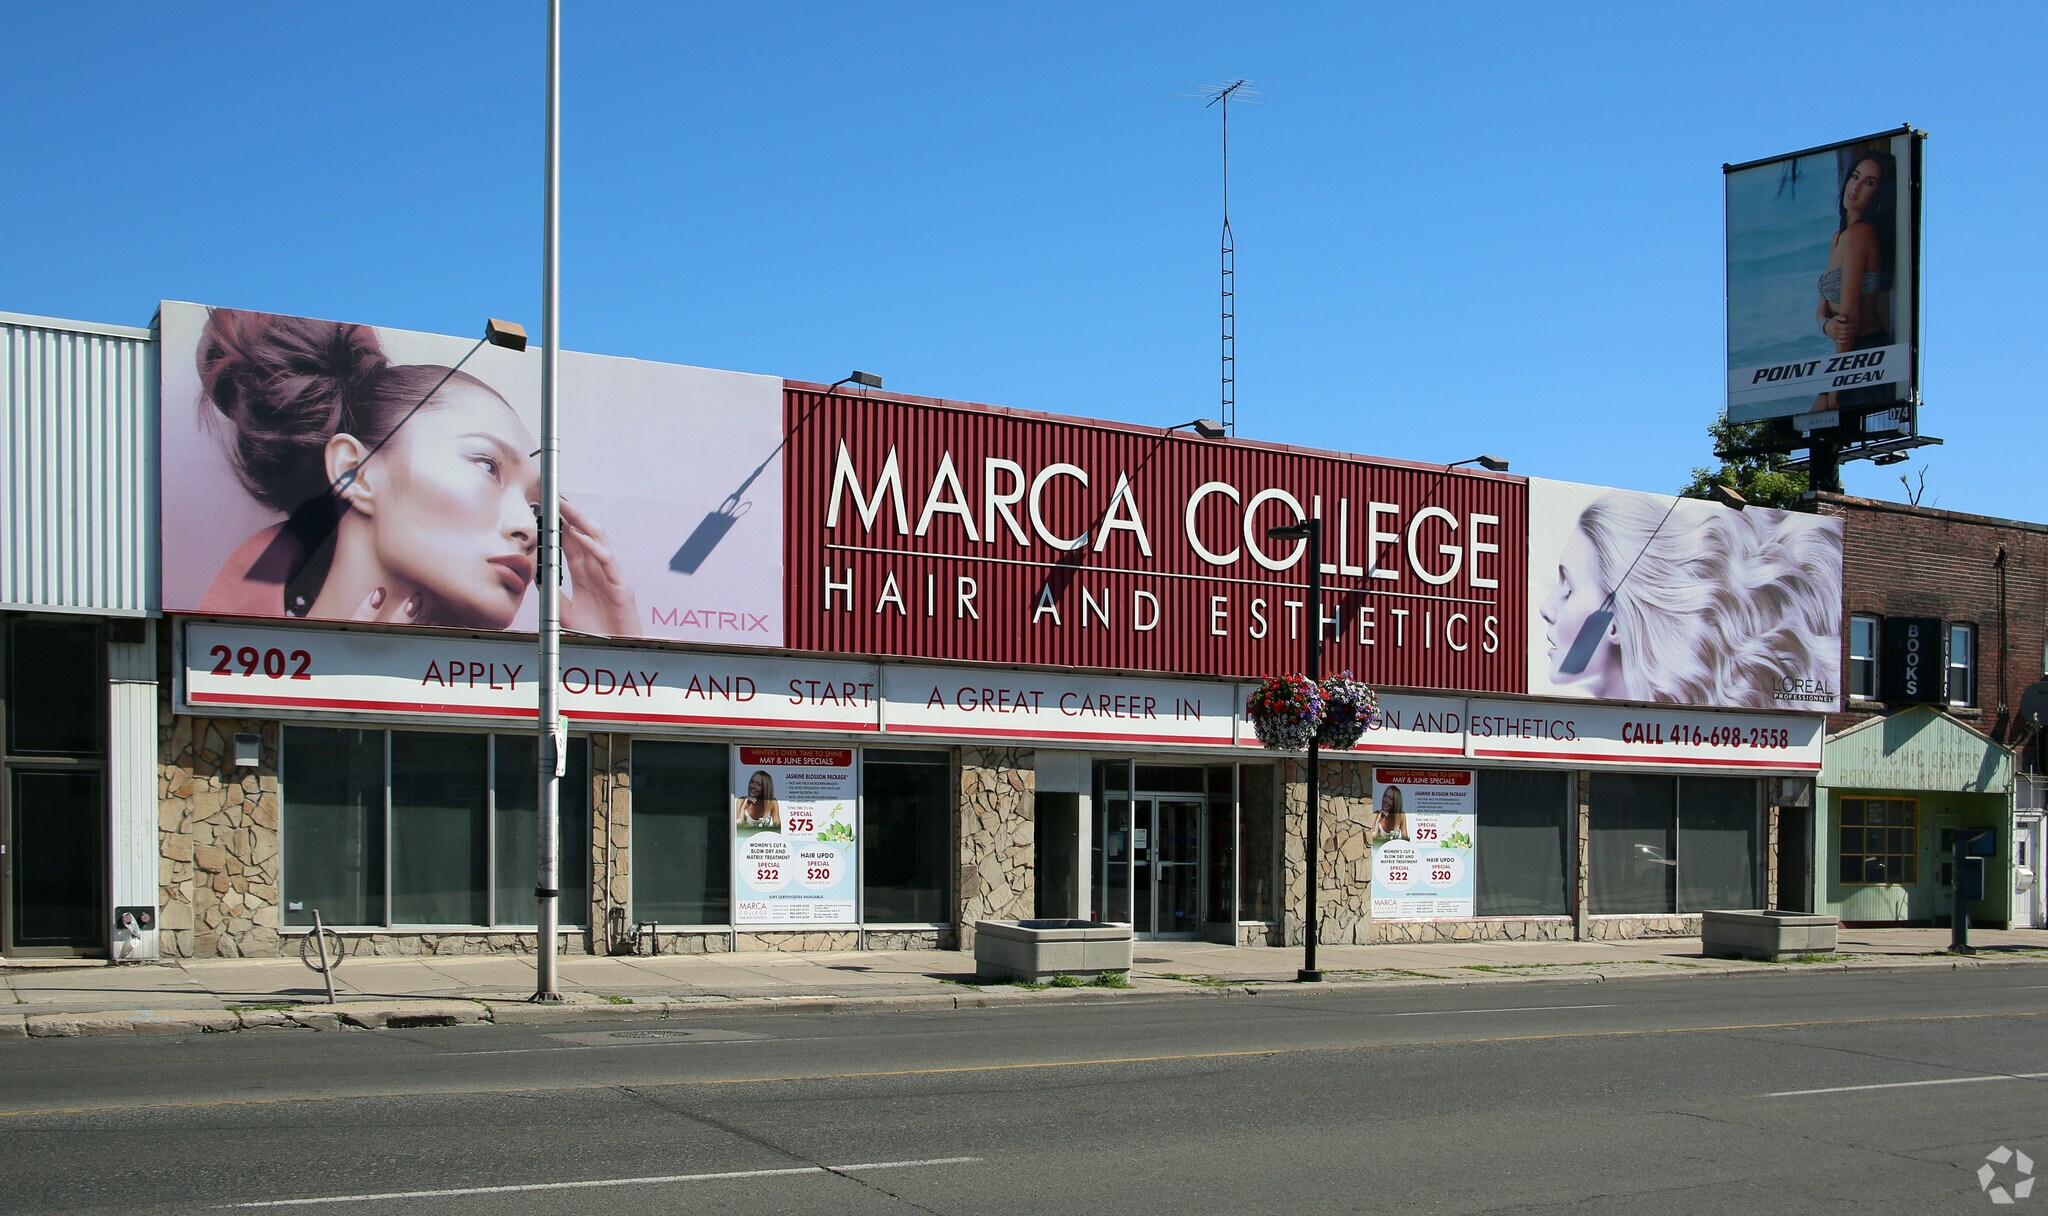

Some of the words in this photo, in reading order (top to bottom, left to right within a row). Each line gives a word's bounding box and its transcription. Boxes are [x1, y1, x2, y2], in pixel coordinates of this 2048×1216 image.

[1752, 360, 1821, 384] POINT
[1824, 351, 1885, 373] ZERO
[1832, 370, 1885, 387] OCEAN
[1889, 407, 1908, 419] 074
[826, 438, 1152, 556] MARCA
[1186, 481, 1498, 588] COLLEGE
[825, 566, 979, 619] HAIR
[1033, 583, 1160, 631] AND
[1211, 596, 1498, 653] ESTHETICS
[652, 607, 769, 632] MATRIX
[210, 645, 311, 680] 2902
[1906, 624, 1919, 695] BOOKS
[422, 660, 523, 691] APPLY
[558, 666, 659, 697] ODAY
[685, 674, 756, 702] AND
[789, 679, 873, 708] START
[927, 686, 945, 710] A
[956, 687, 1043, 714] GREAT
[1059, 692, 1156, 720] CAREER
[1176, 698, 1200, 721] IN
[1413, 711, 1460, 734] AND
[1471, 715, 1581, 741] ESTHETICS.
[1773, 693, 1833, 702] PROFESSIONNEL
[1622, 722, 1664, 744] CALL
[1670, 724, 1788, 749] 416-698-2558
[789, 818, 814, 832] $75
[1416, 828, 1437, 840] $75
[757, 869, 779, 880] $22
[807, 868, 830, 880] $20
[1389, 872, 1408, 881] $22
[1432, 871, 1451, 880] $20
[739, 902, 767, 910] MARCA
